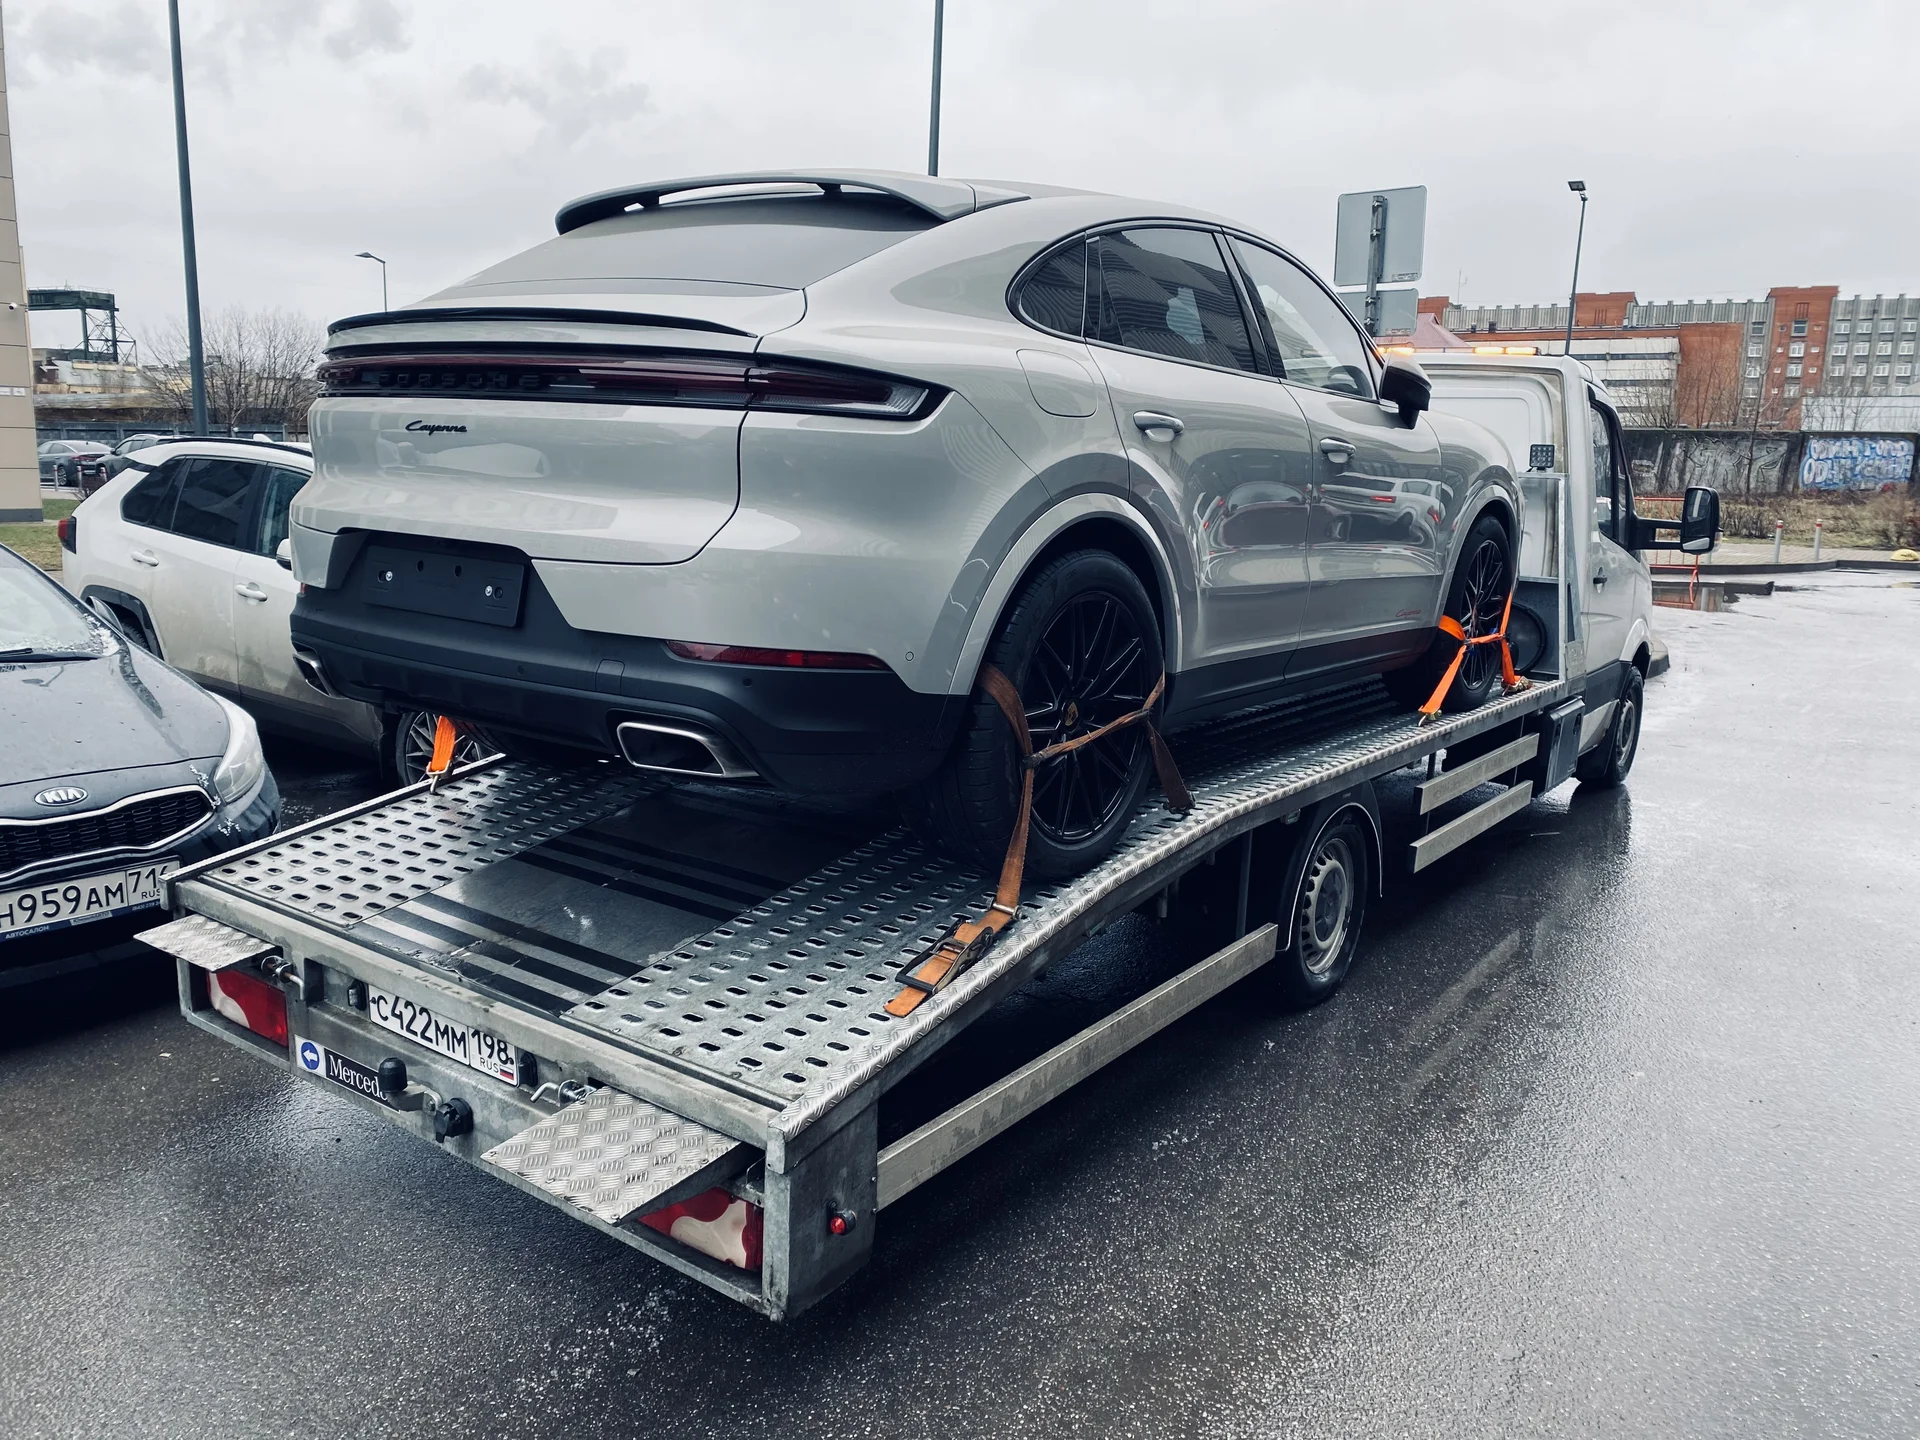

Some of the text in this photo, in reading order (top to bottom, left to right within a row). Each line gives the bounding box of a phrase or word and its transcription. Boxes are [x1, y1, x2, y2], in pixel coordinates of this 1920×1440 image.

[405, 420, 468, 436] Cayenne
[42, 788, 82, 803] KIA
[141, 888, 160, 900] RUS
[5, 925, 50, 940] АВТОСАЛОН
[471, 1029, 510, 1066] 198
[480, 1056, 499, 1074] RUS
